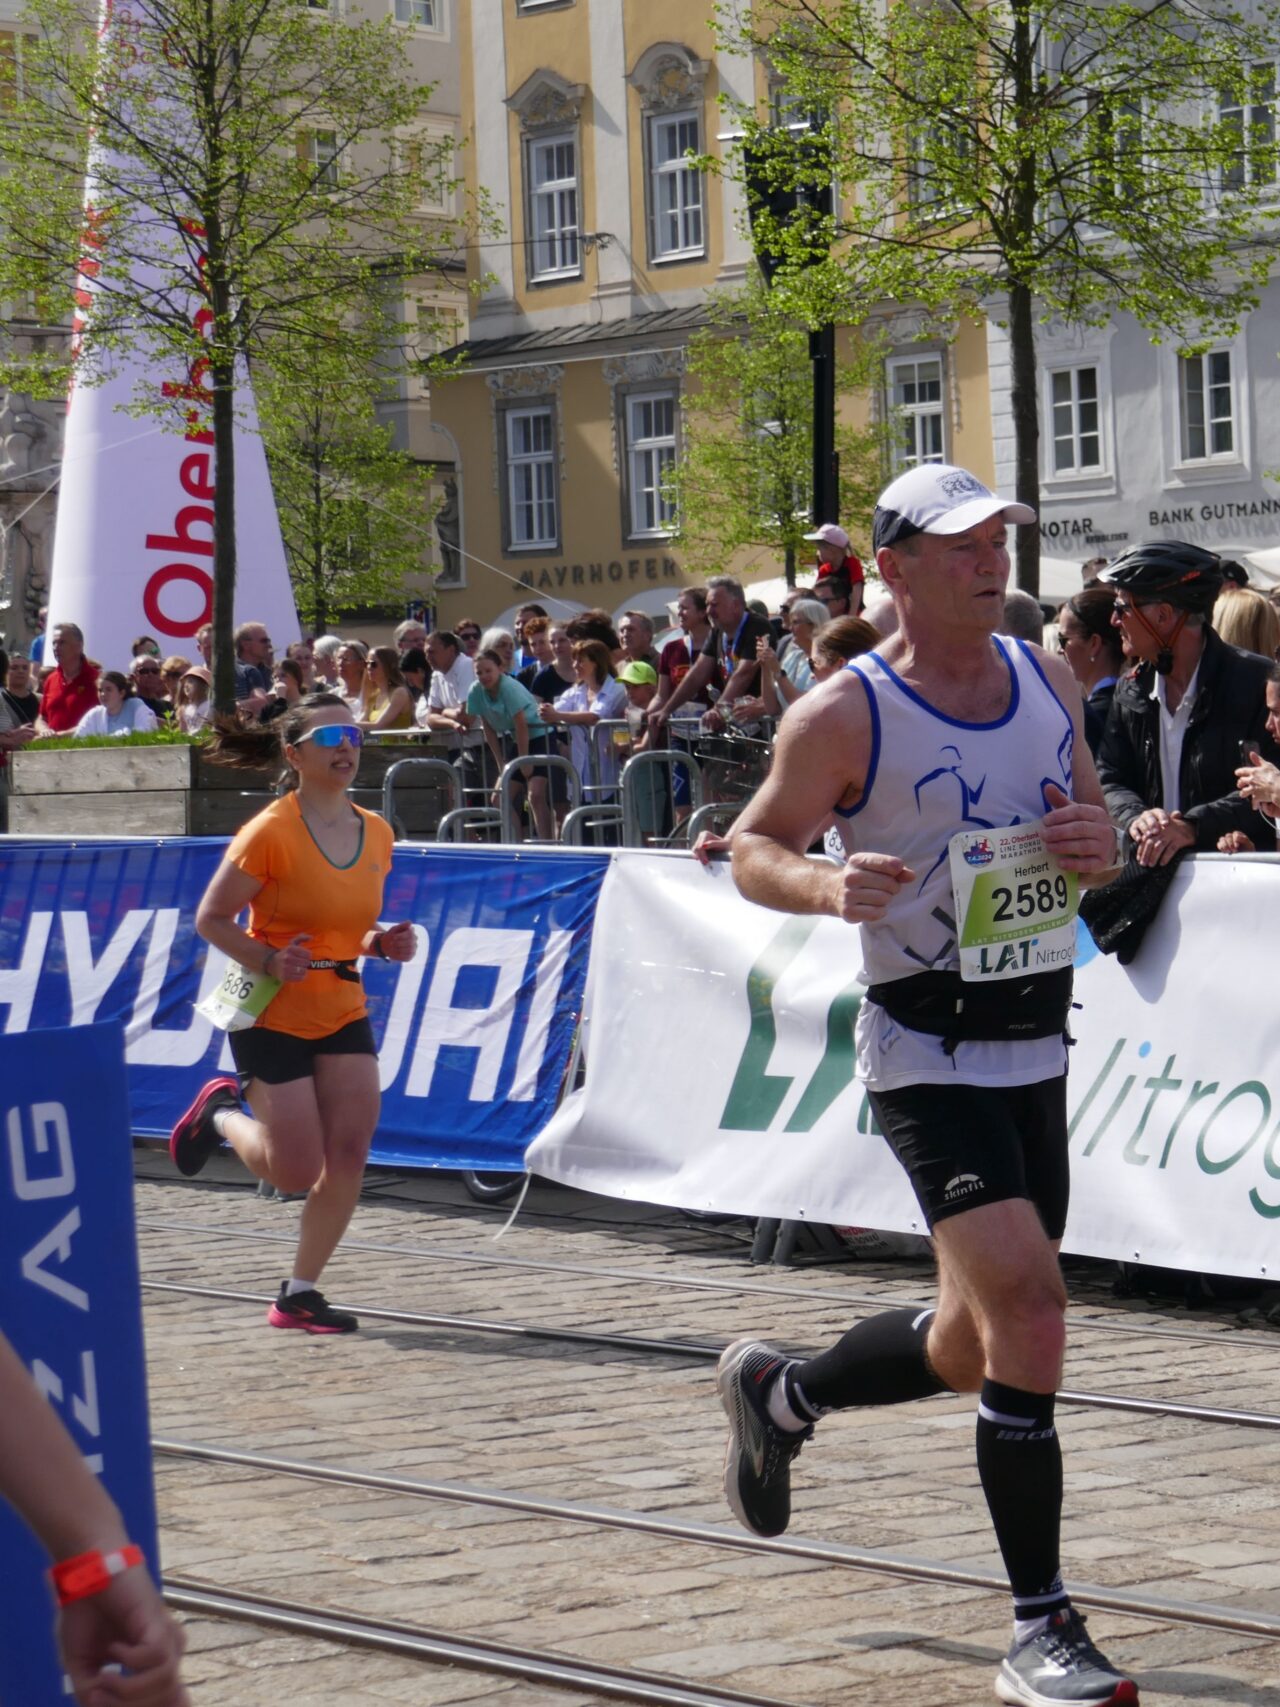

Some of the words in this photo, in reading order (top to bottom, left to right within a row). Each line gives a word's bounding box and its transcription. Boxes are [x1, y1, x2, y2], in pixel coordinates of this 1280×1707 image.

[1149, 508, 1194, 526] BANK
[516, 556, 677, 591] MAYRHOFER
[1015, 862, 1050, 878] Herbert
[991, 874, 1069, 923] 2589
[980, 939, 1033, 974] LAT
[224, 972, 254, 1000] 886
[945, 1181, 985, 1200] skinfit
